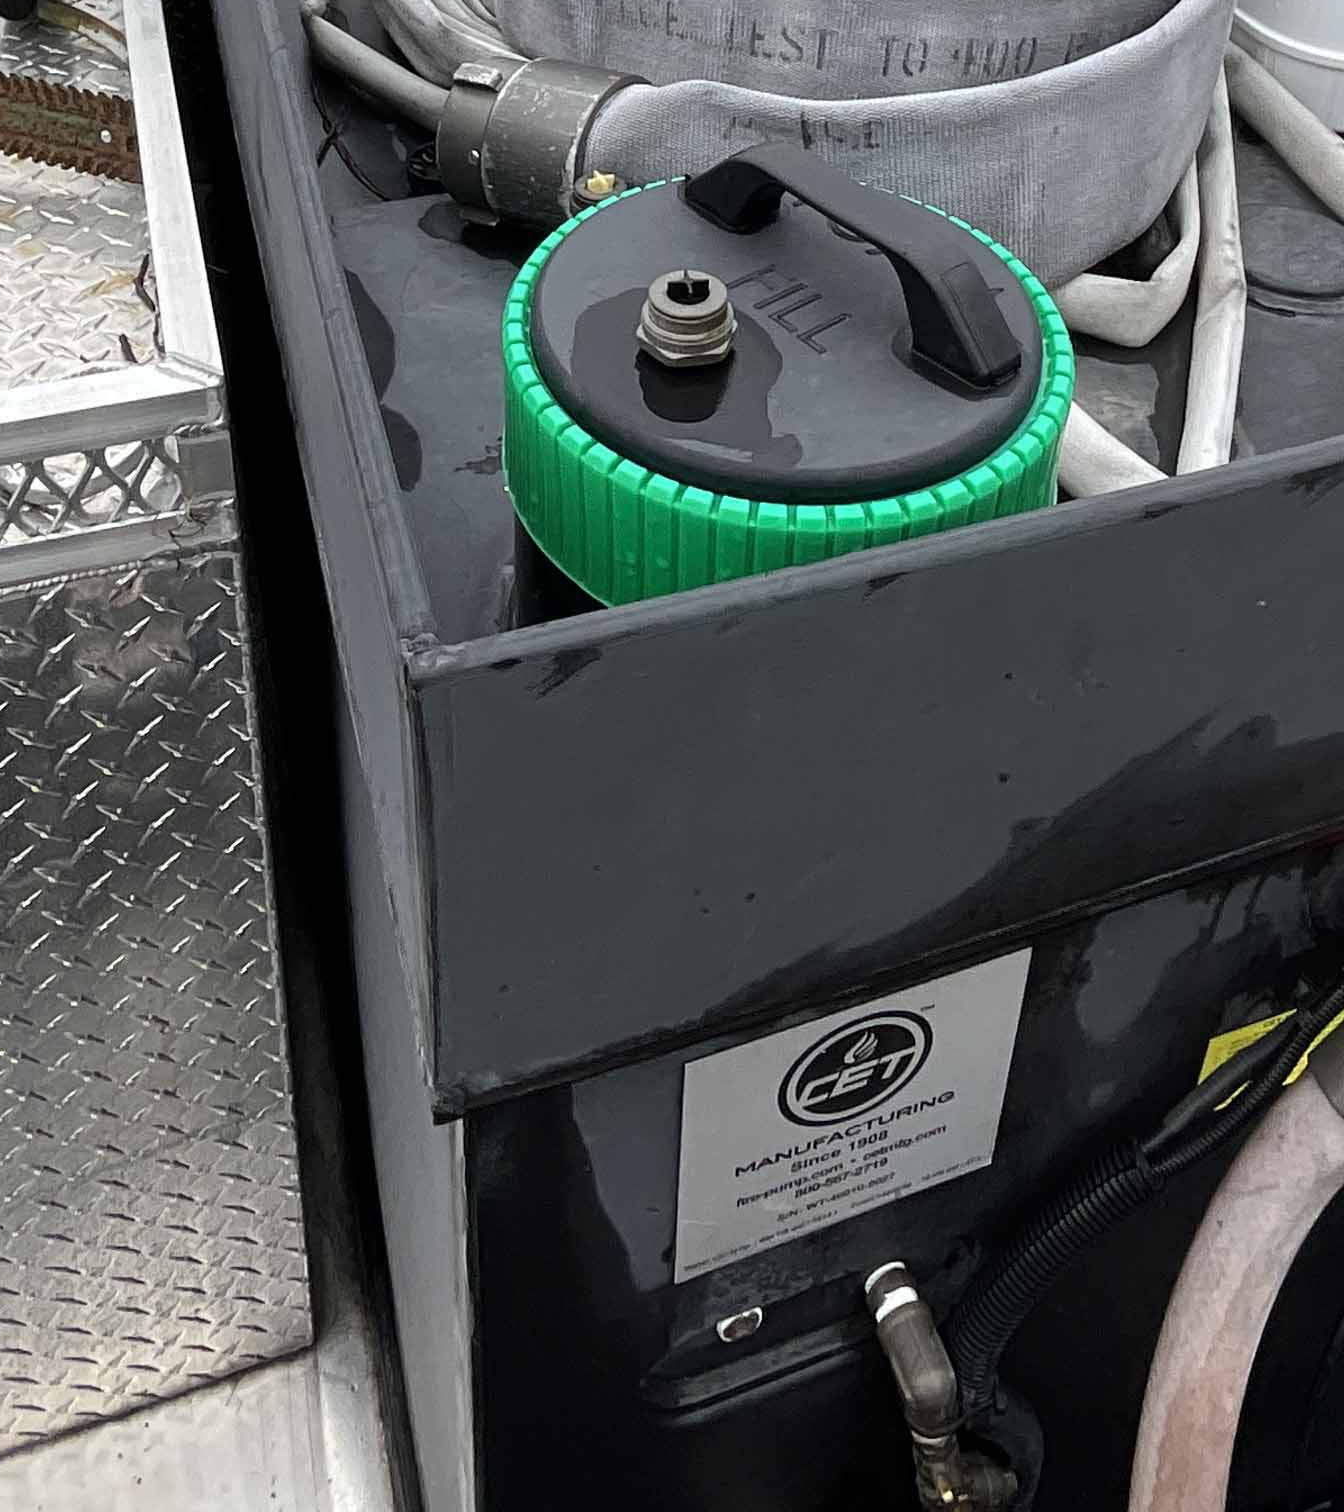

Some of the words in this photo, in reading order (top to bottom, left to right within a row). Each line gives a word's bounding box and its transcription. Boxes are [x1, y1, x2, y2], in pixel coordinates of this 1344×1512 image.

[725, 12, 838, 71] TEST
[877, 34, 929, 78] TO
[724, 262, 854, 356] FILL
[799, 1045, 917, 1107] CET
[734, 1090, 955, 1178] MANUFACTURING
[790, 1148, 842, 1173] Since
[848, 1129, 889, 1152] 1908
